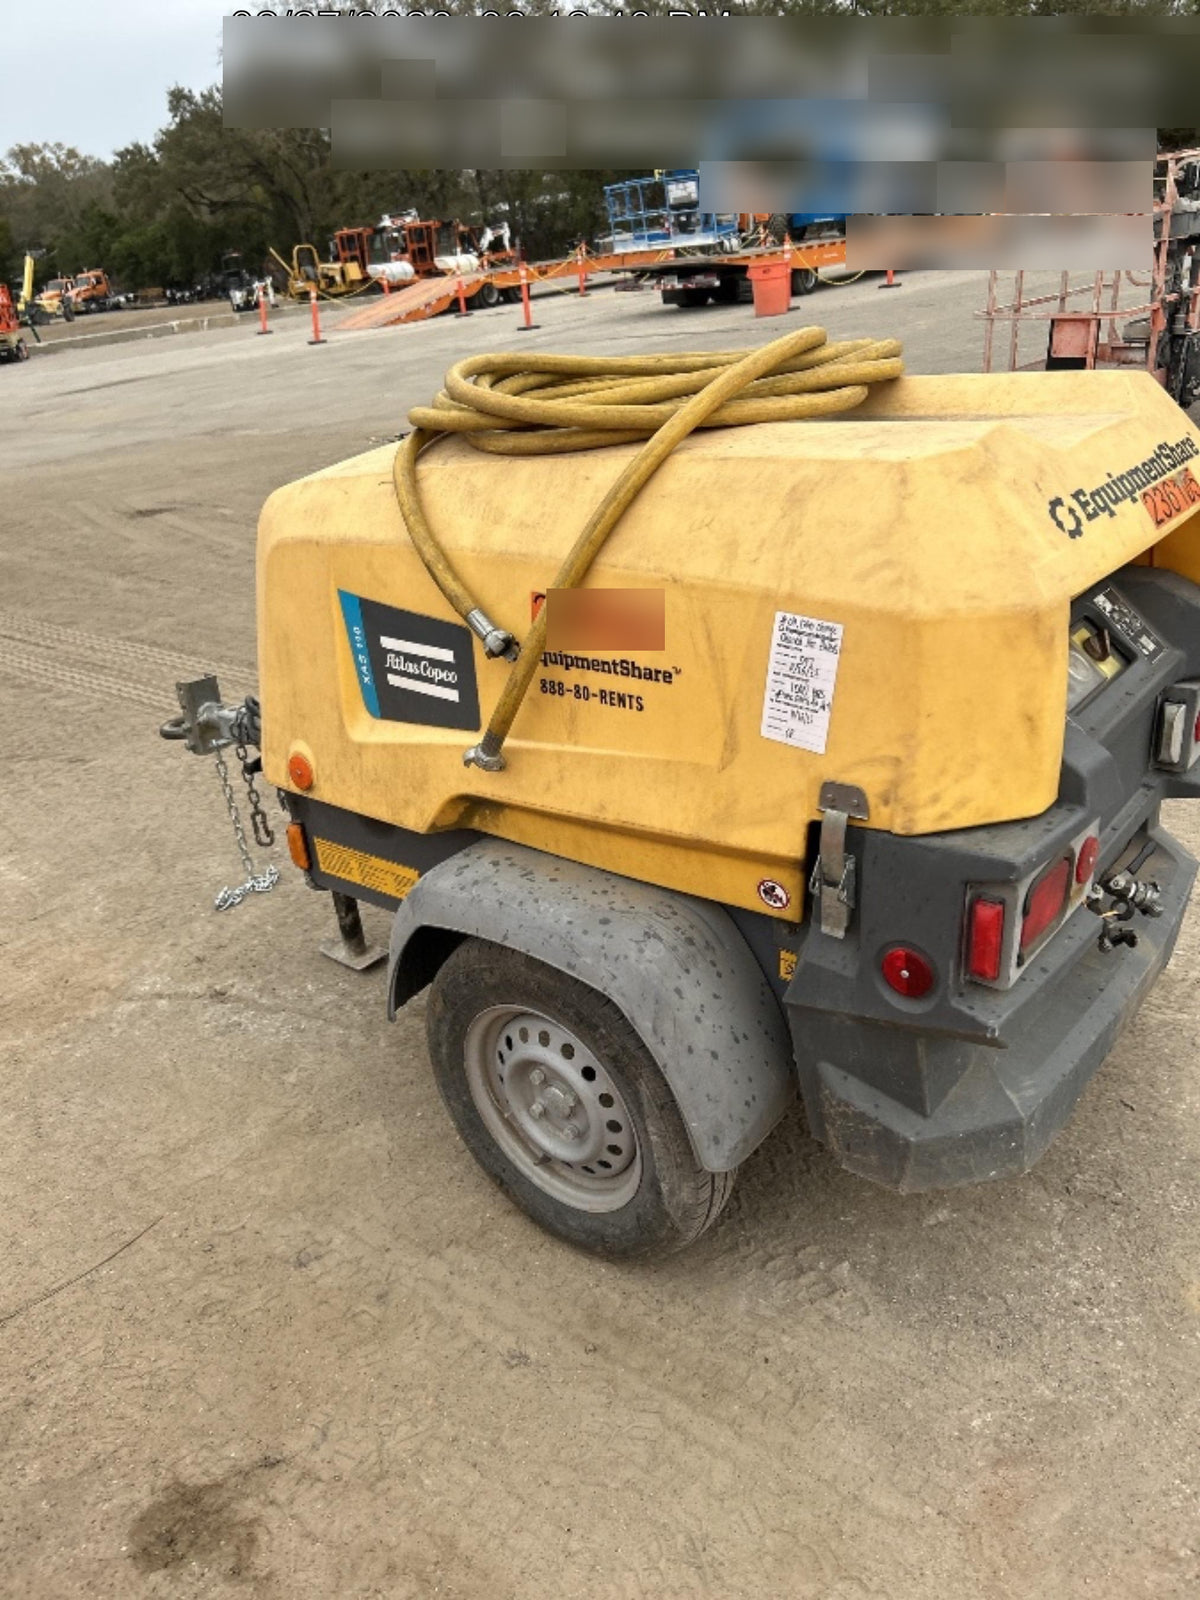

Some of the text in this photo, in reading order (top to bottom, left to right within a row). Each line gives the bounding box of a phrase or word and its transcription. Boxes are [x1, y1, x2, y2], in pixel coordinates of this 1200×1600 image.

[1070, 437, 1199, 521] EquipmentShare
[385, 653, 458, 684] Atlas Copco
[541, 651, 673, 685] quipmentShare
[540, 678, 644, 712] 888-80-RENTS
